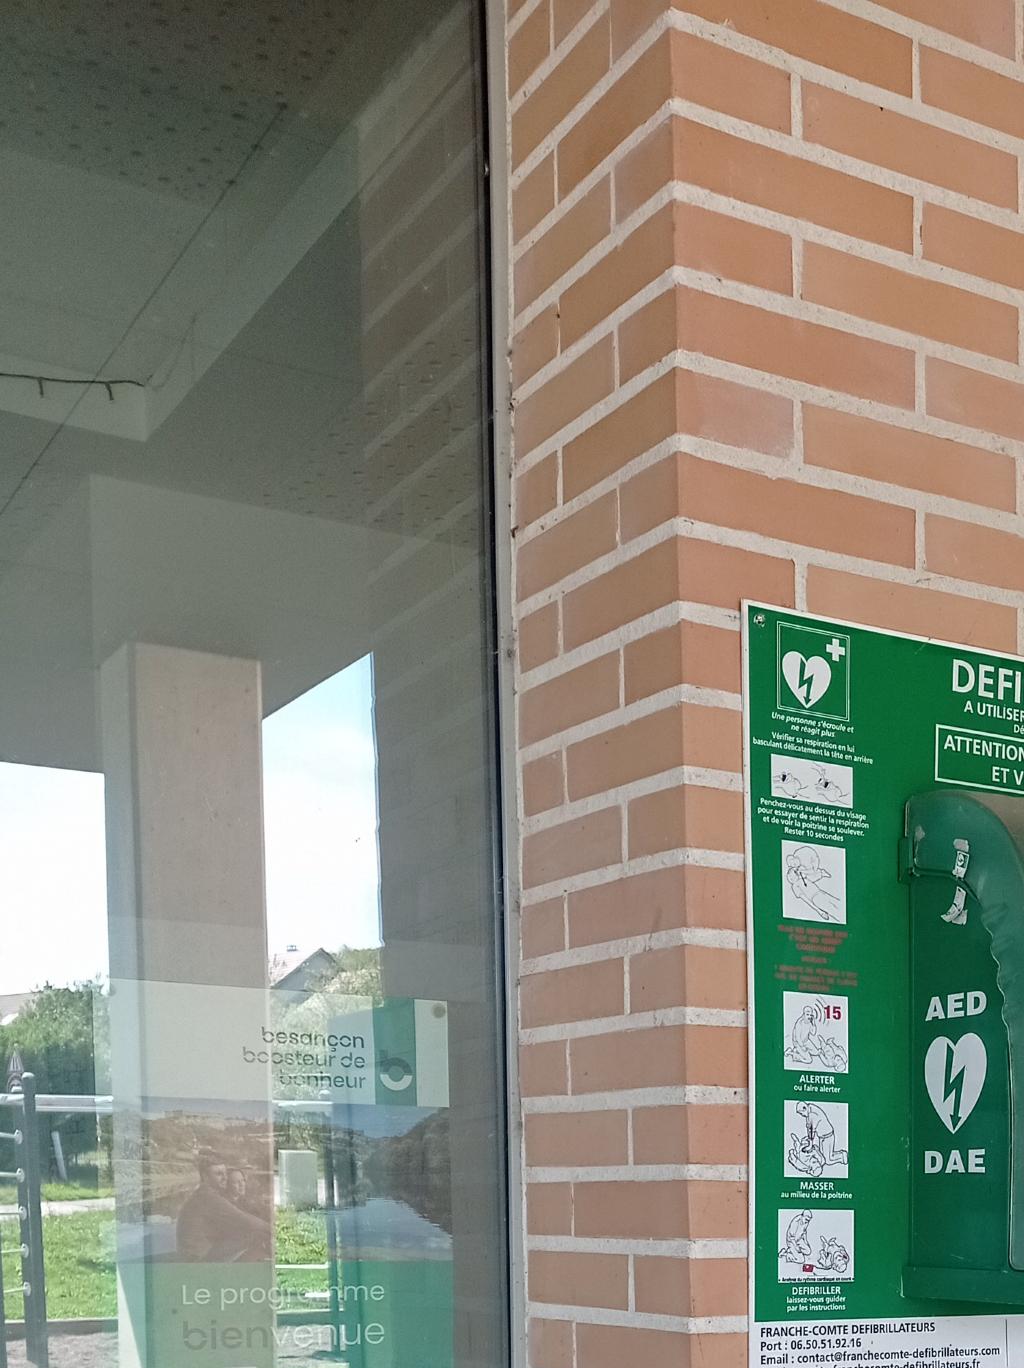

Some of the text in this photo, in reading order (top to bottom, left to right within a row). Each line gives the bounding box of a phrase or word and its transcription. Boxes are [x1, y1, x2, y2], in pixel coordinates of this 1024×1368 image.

[964, 700, 974, 714] A
[771, 712, 855, 734] Une personne s'écroule et
[791, 724, 800, 732] ne
[801, 725, 820, 736] réagit
[771, 731, 795, 742] Vérifier
[804, 737, 837, 750] respiration
[752, 736, 782, 749] basculant
[783, 741, 823, 756] délicatement
[824, 748, 830, 756] la
[831, 750, 844, 759] tête
[853, 754, 873, 764] arrière
[992, 766, 1009, 784] ET
[760, 798, 867, 821] Penchez-vous au dessus du visage
[762, 815, 770, 823] et
[771, 816, 779, 824] de
[780, 818, 794, 826] voir
[795, 819, 801, 827] la
[802, 820, 827, 831] poitrine
[836, 825, 865, 837] soulever.
[774, 809, 799, 819] essayer
[800, 811, 808, 820] de
[809, 814, 828, 823] sentir
[829, 816, 835, 824] la
[836, 817, 869, 829] respiration
[784, 826, 844, 841] Rester 10 secondes
[823, 1005, 842, 1020] 15
[924, 990, 988, 1022] AED
[261, 1026, 364, 1052] besançon
[242, 1046, 365, 1068] boosteur de
[280, 1069, 366, 1088] bonheur
[799, 1074, 835, 1086] ALERTER
[803, 1084, 818, 1092] faire
[819, 1085, 841, 1093] alerter
[923, 1148, 987, 1175] DAE
[800, 1181, 834, 1191] MASSER
[827, 1191, 852, 1200] poitrine
[181, 1284, 385, 1312] Le programme
[787, 1295, 846, 1304] laissez-vous guider
[792, 1286, 841, 1295] DEFIBRILLER
[809, 1303, 846, 1311] instructions
[183, 1320, 385, 1350] bienvenue
[760, 1322, 936, 1338] FRANCHE-COMTE DEFIBRILLATEURS
[760, 1341, 782, 1351] Port
[790, 1338, 862, 1350] 06.50.51.92.16
[760, 1354, 788, 1365] Email
[797, 1346, 1000, 1363] contact@franchecomte-defibrillateurs.com
